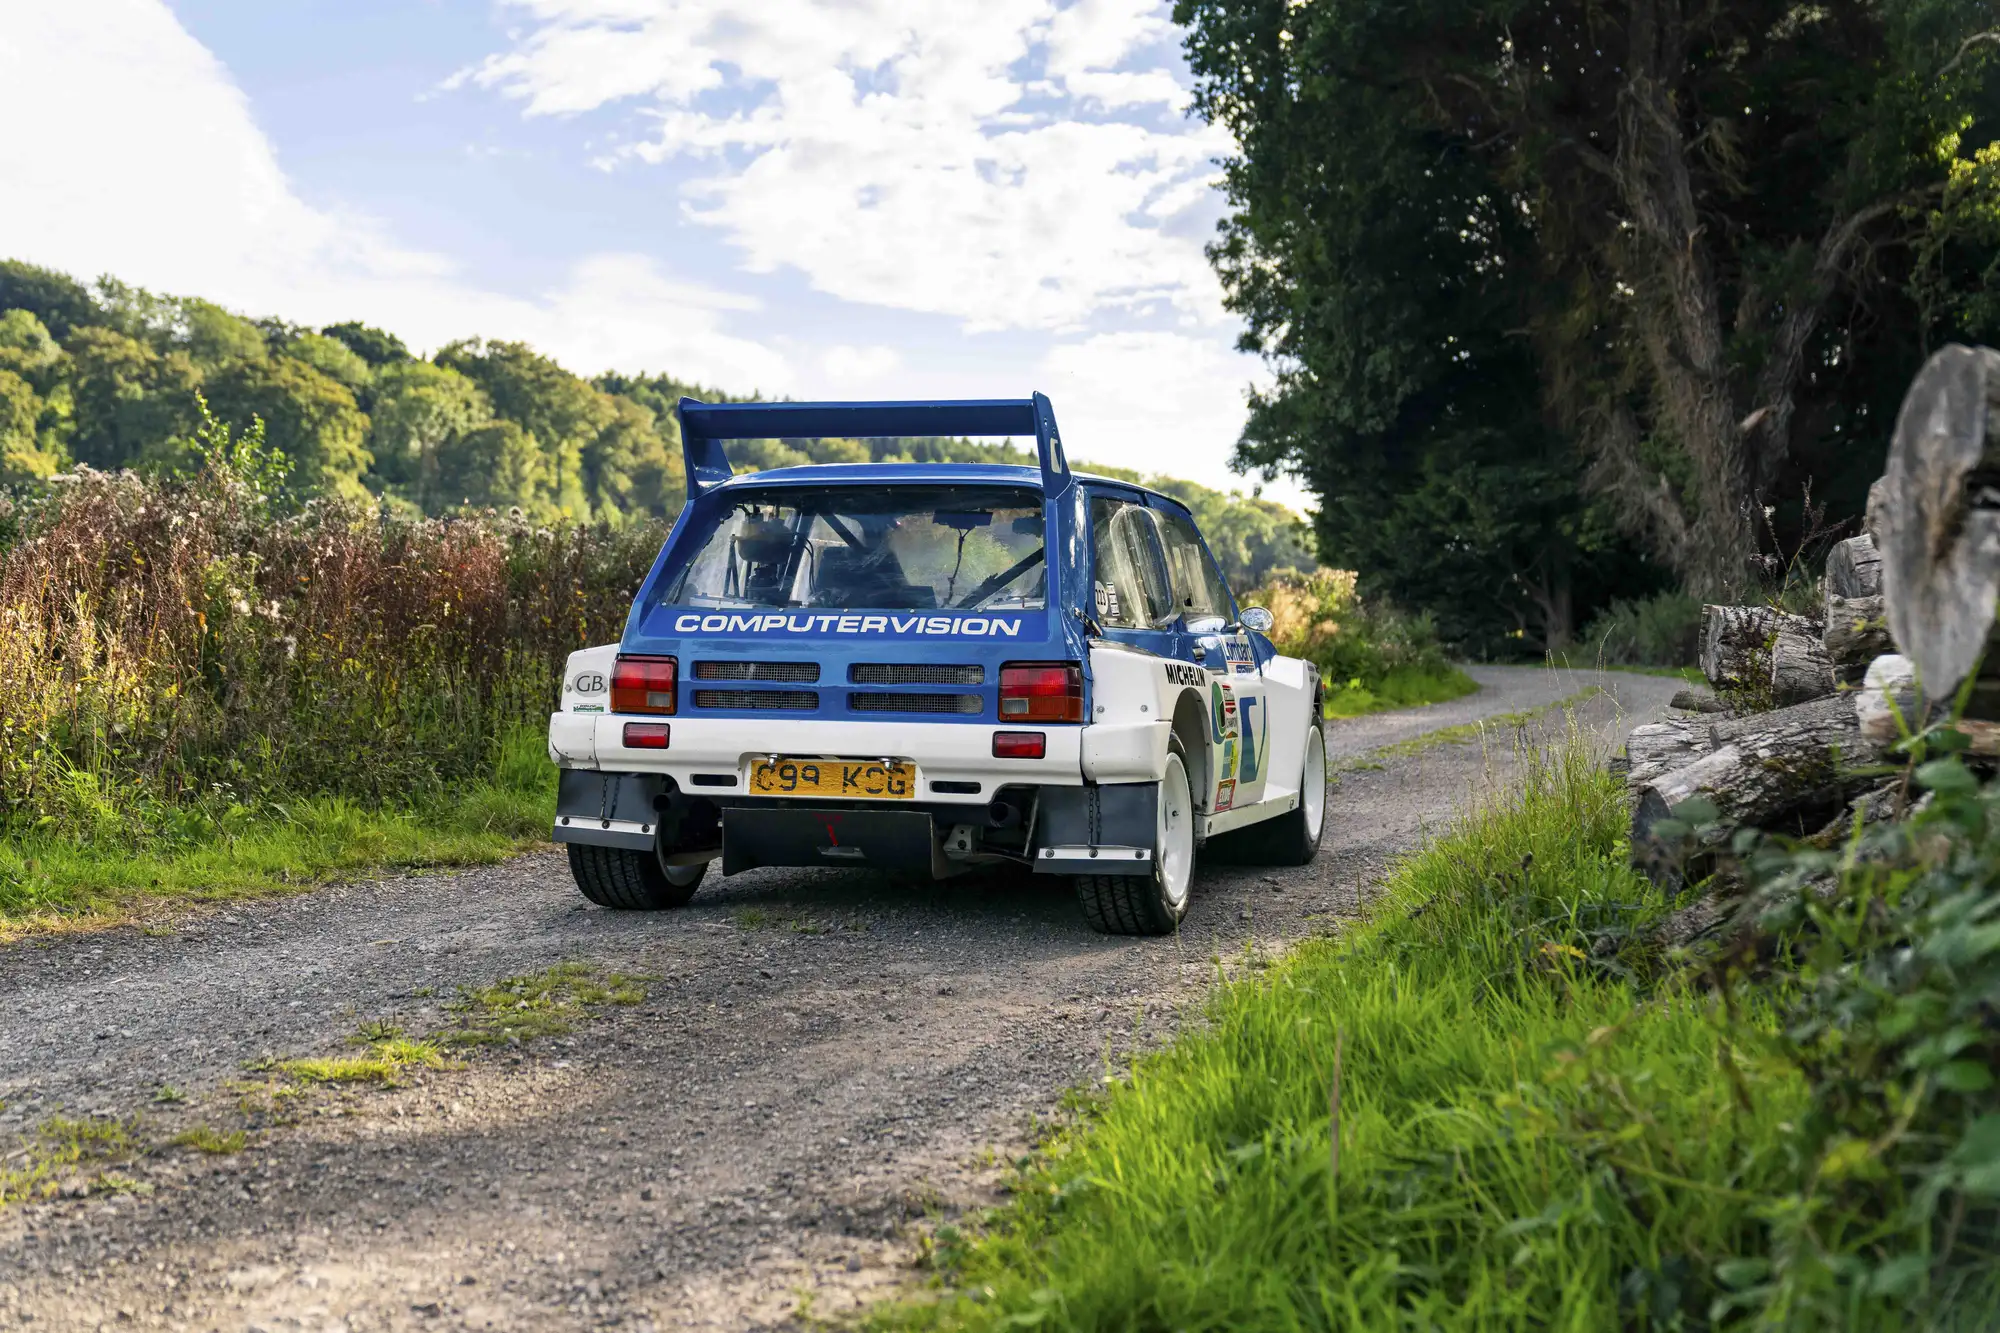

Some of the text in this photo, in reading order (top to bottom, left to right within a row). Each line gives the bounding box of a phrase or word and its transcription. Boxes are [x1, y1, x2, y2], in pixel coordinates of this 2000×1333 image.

[674, 615, 1022, 636] COMPUTERVISION
[576, 675, 604, 692] GB
[1164, 663, 1206, 687] MICHELIN
